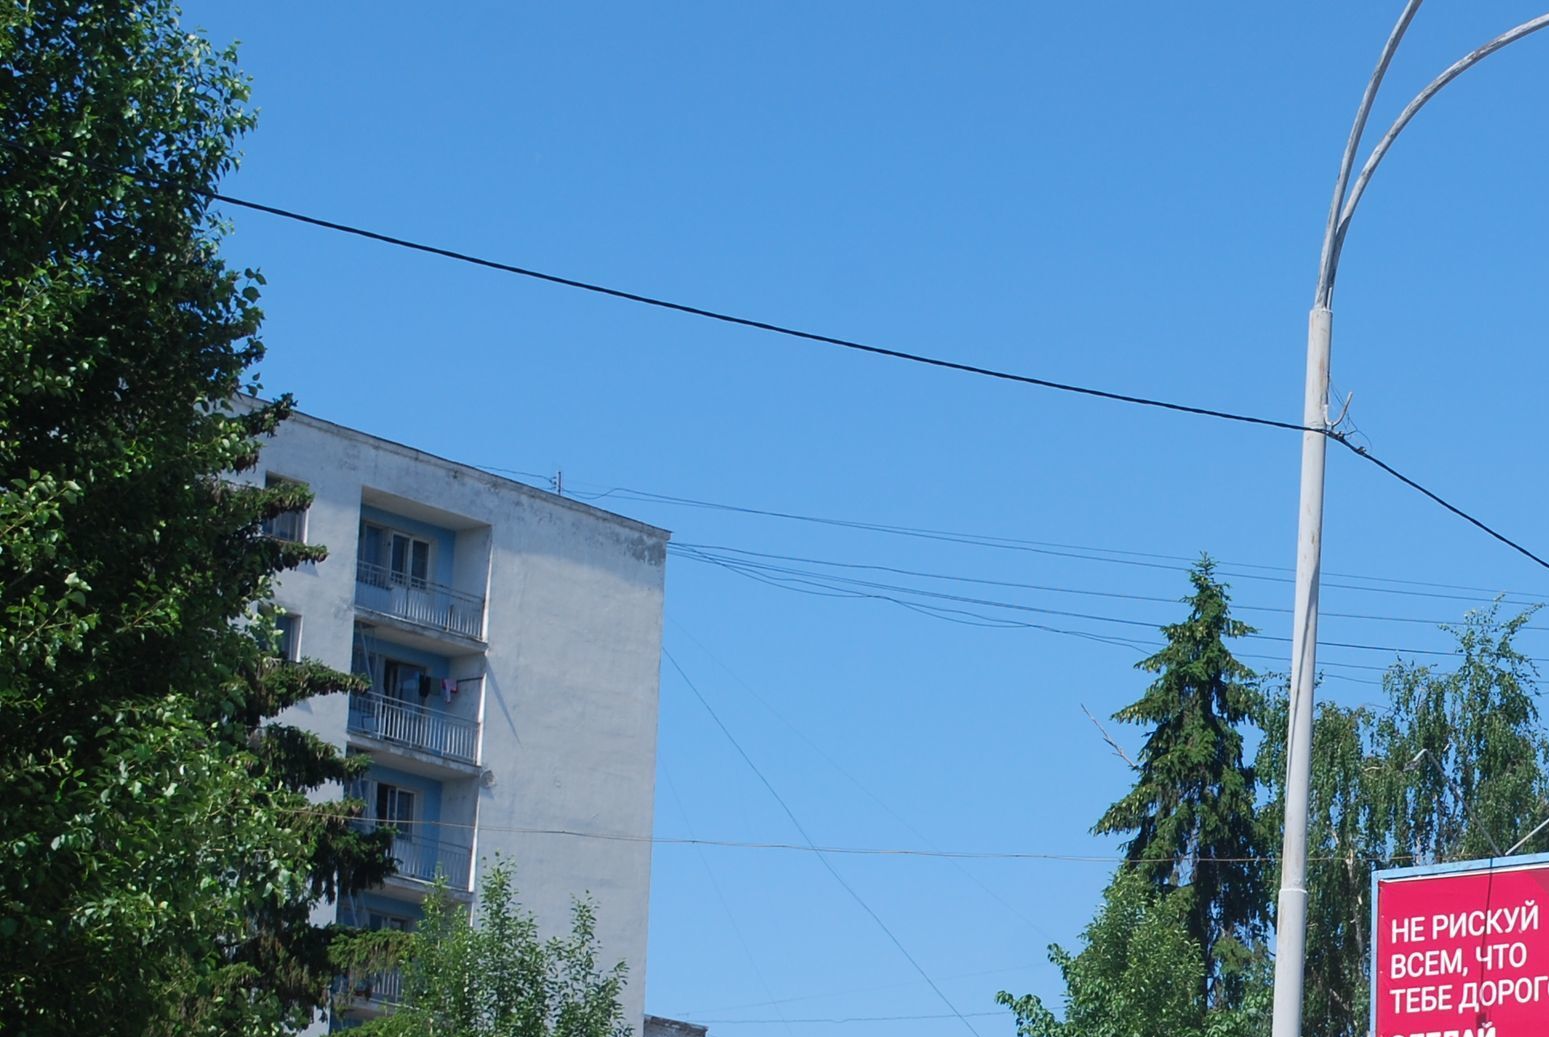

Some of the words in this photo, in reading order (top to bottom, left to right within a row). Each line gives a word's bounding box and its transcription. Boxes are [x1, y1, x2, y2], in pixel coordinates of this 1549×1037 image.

[1391, 917, 1425, 944] НЕ
[1432, 900, 1539, 940] РИСКУЙ
[1390, 948, 1468, 979] ВСЕМ,
[1475, 942, 1527, 971] ЧТО
[1389, 985, 1453, 1014] ТЕБЕ
